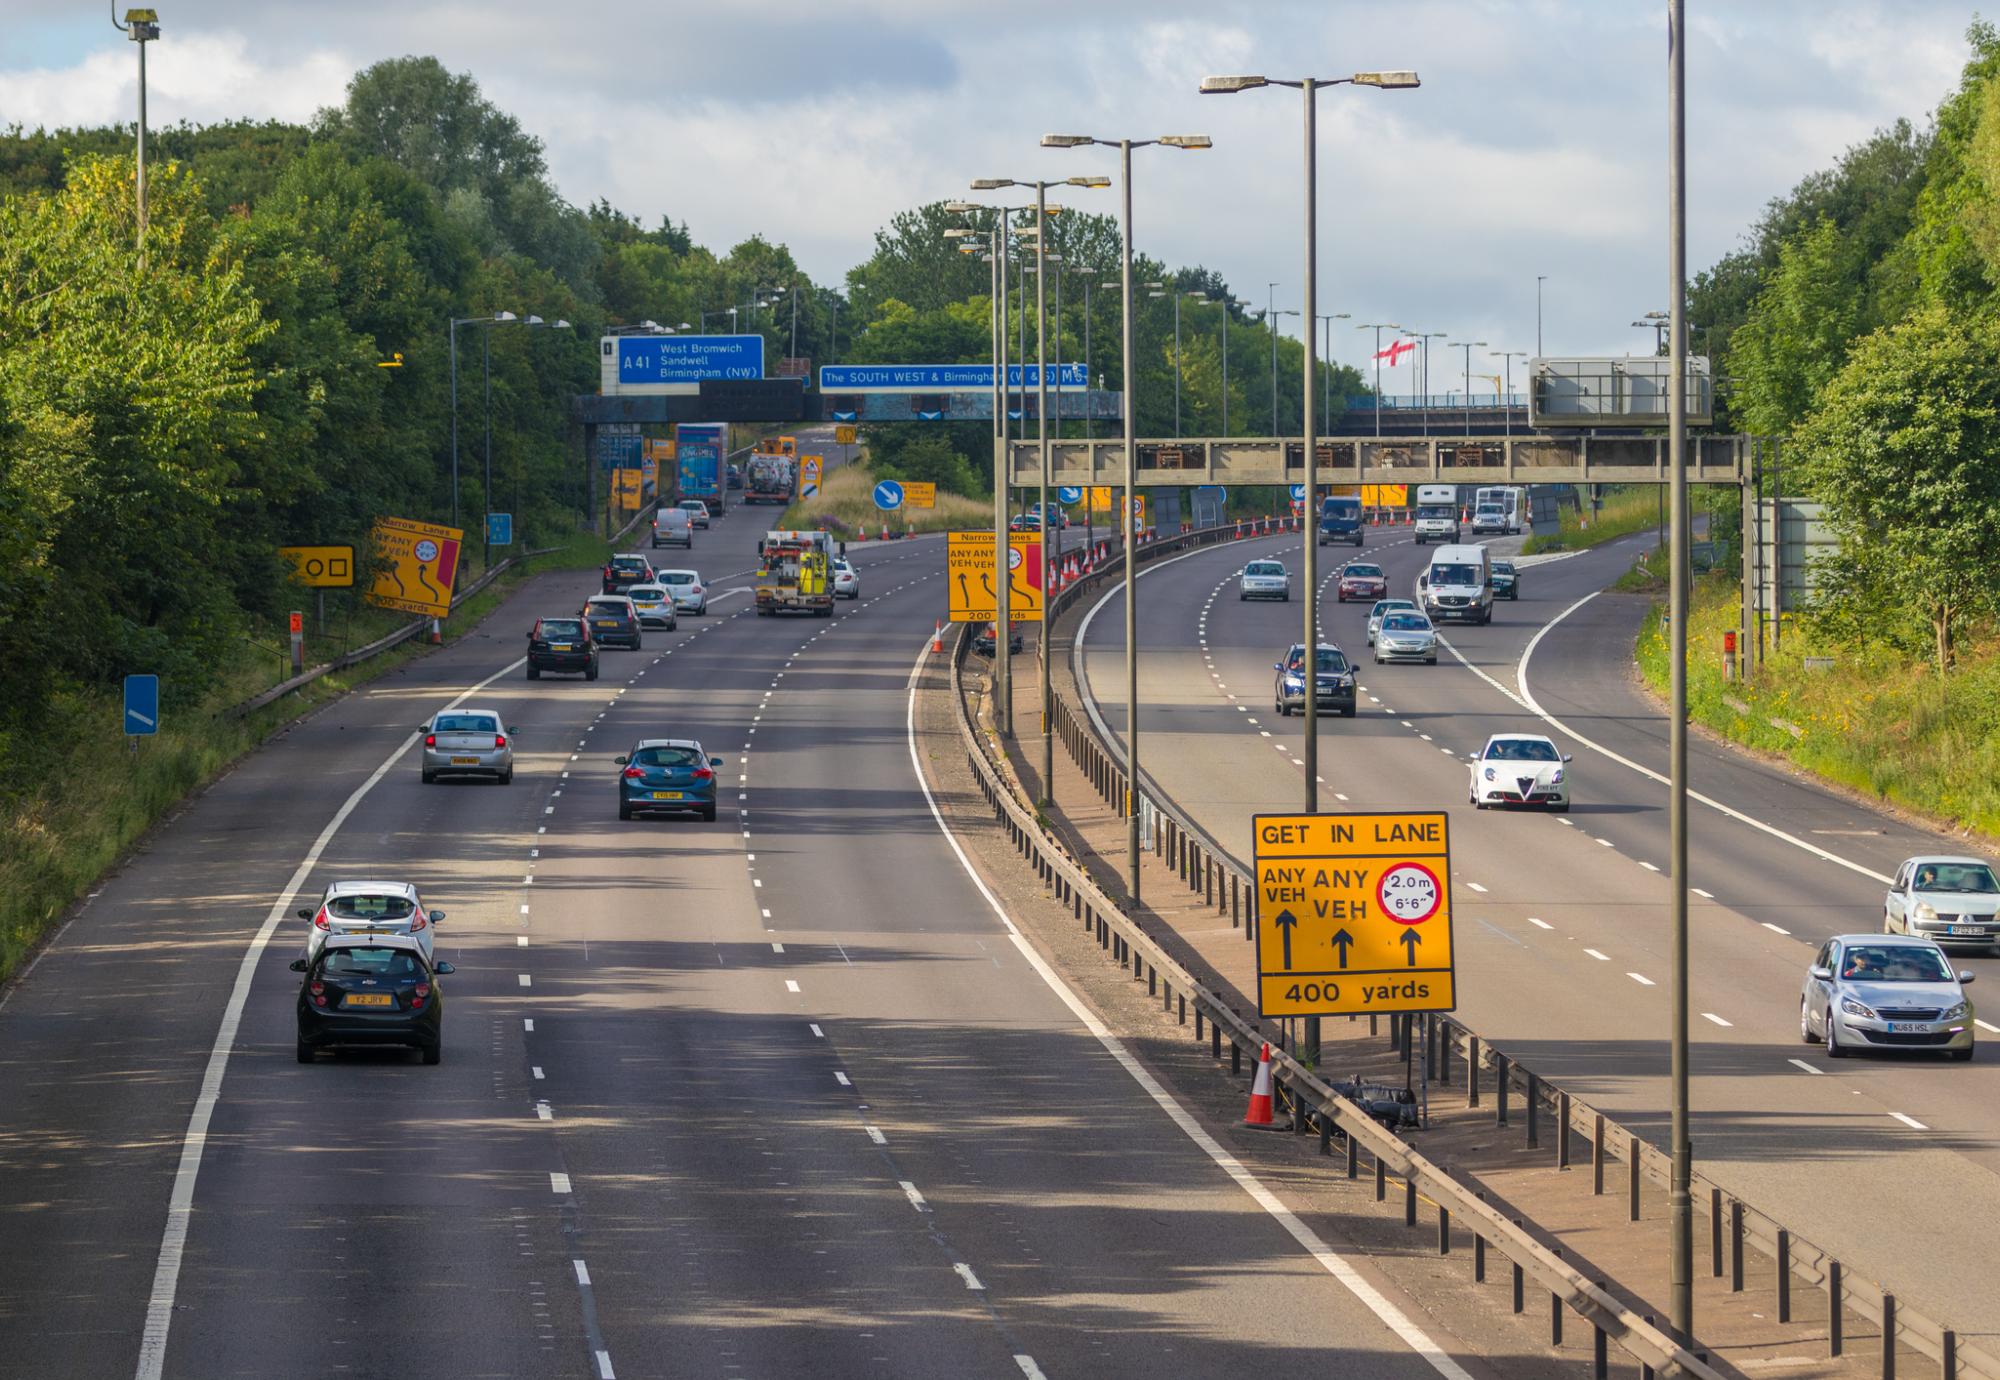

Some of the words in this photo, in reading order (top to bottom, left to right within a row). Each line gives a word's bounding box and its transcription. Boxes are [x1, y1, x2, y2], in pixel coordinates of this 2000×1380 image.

[660, 343, 687, 354] West
[691, 343, 743, 354] Bromwich
[623, 356, 633, 369] A
[635, 356, 651, 369] 41
[660, 356, 709, 365] Sandwell
[660, 368, 721, 379] Birmingham
[726, 367, 757, 378] (NW)
[825, 372, 845, 382] The
[850, 372, 889, 382] SOUTH
[894, 372, 925, 382] WEST
[931, 372, 939, 381] &
[1030, 371, 1038, 381] &
[423, 525, 451, 536] Lanes
[391, 534, 412, 545] ANY
[961, 533, 997, 541] Narrow
[389, 546, 410, 558] VEH
[951, 550, 971, 558] ANY
[973, 549, 995, 557] ANY
[951, 559, 972, 567] VEH
[974, 560, 995, 568] VEH
[400, 602, 428, 613] yards
[968, 612, 991, 620] 200
[1262, 825, 1310, 844] GET
[1331, 824, 1354, 843] IN
[1375, 823, 1440, 842] LANE
[1263, 868, 1306, 884] ANY
[1313, 870, 1369, 888] ANY
[1265, 887, 1305, 902] VEH
[1314, 900, 1367, 919] VEH
[1284, 983, 1340, 1002] 400
[1362, 980, 1430, 1004] yards
